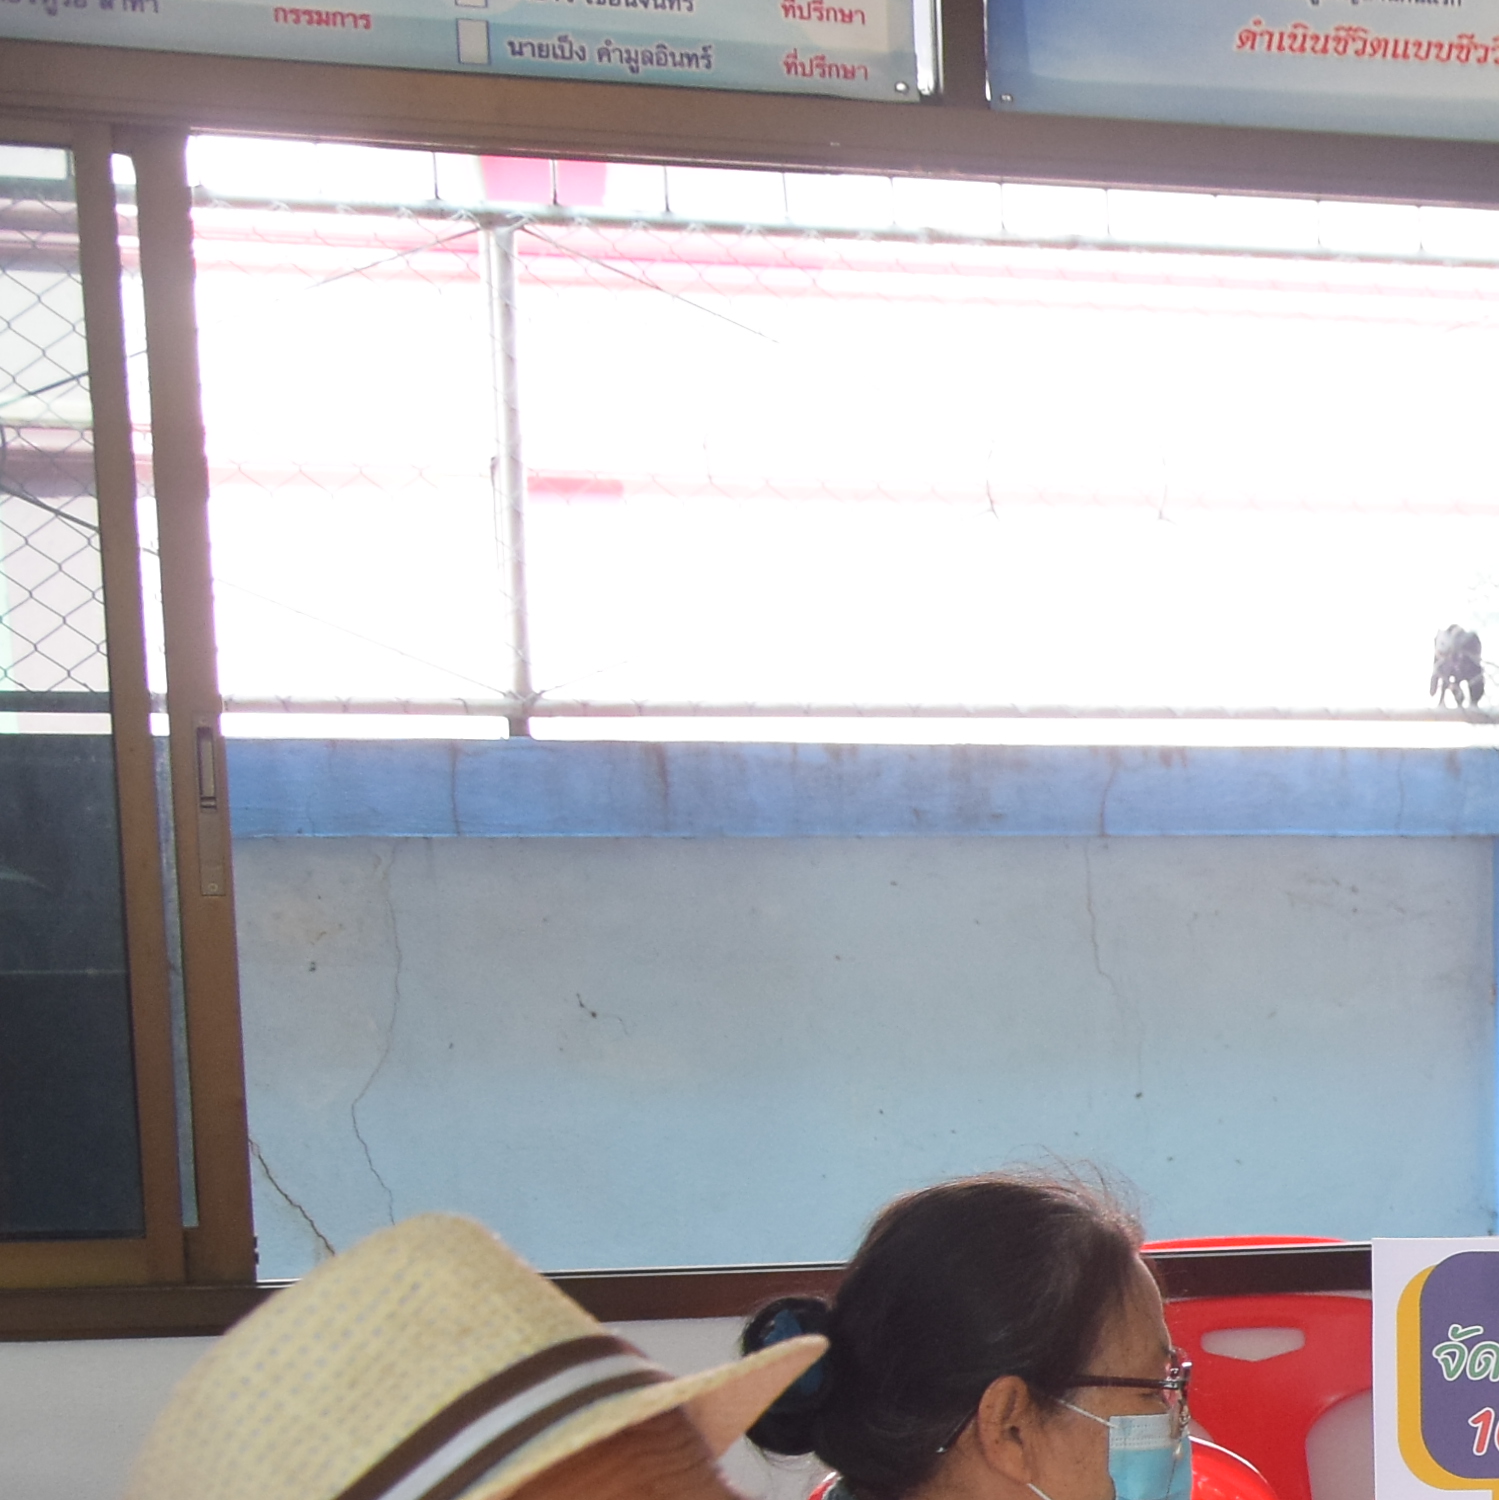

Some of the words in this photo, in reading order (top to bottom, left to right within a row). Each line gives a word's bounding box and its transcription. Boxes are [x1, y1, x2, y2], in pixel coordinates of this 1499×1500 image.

[272, 6, 372, 30] กรรมการ
[780, 0, 866, 25] ทปรึกษา
[597, 40, 715, 75] คำมูลอินทร์
[783, 47, 868, 81] ที่ปรึกษา
